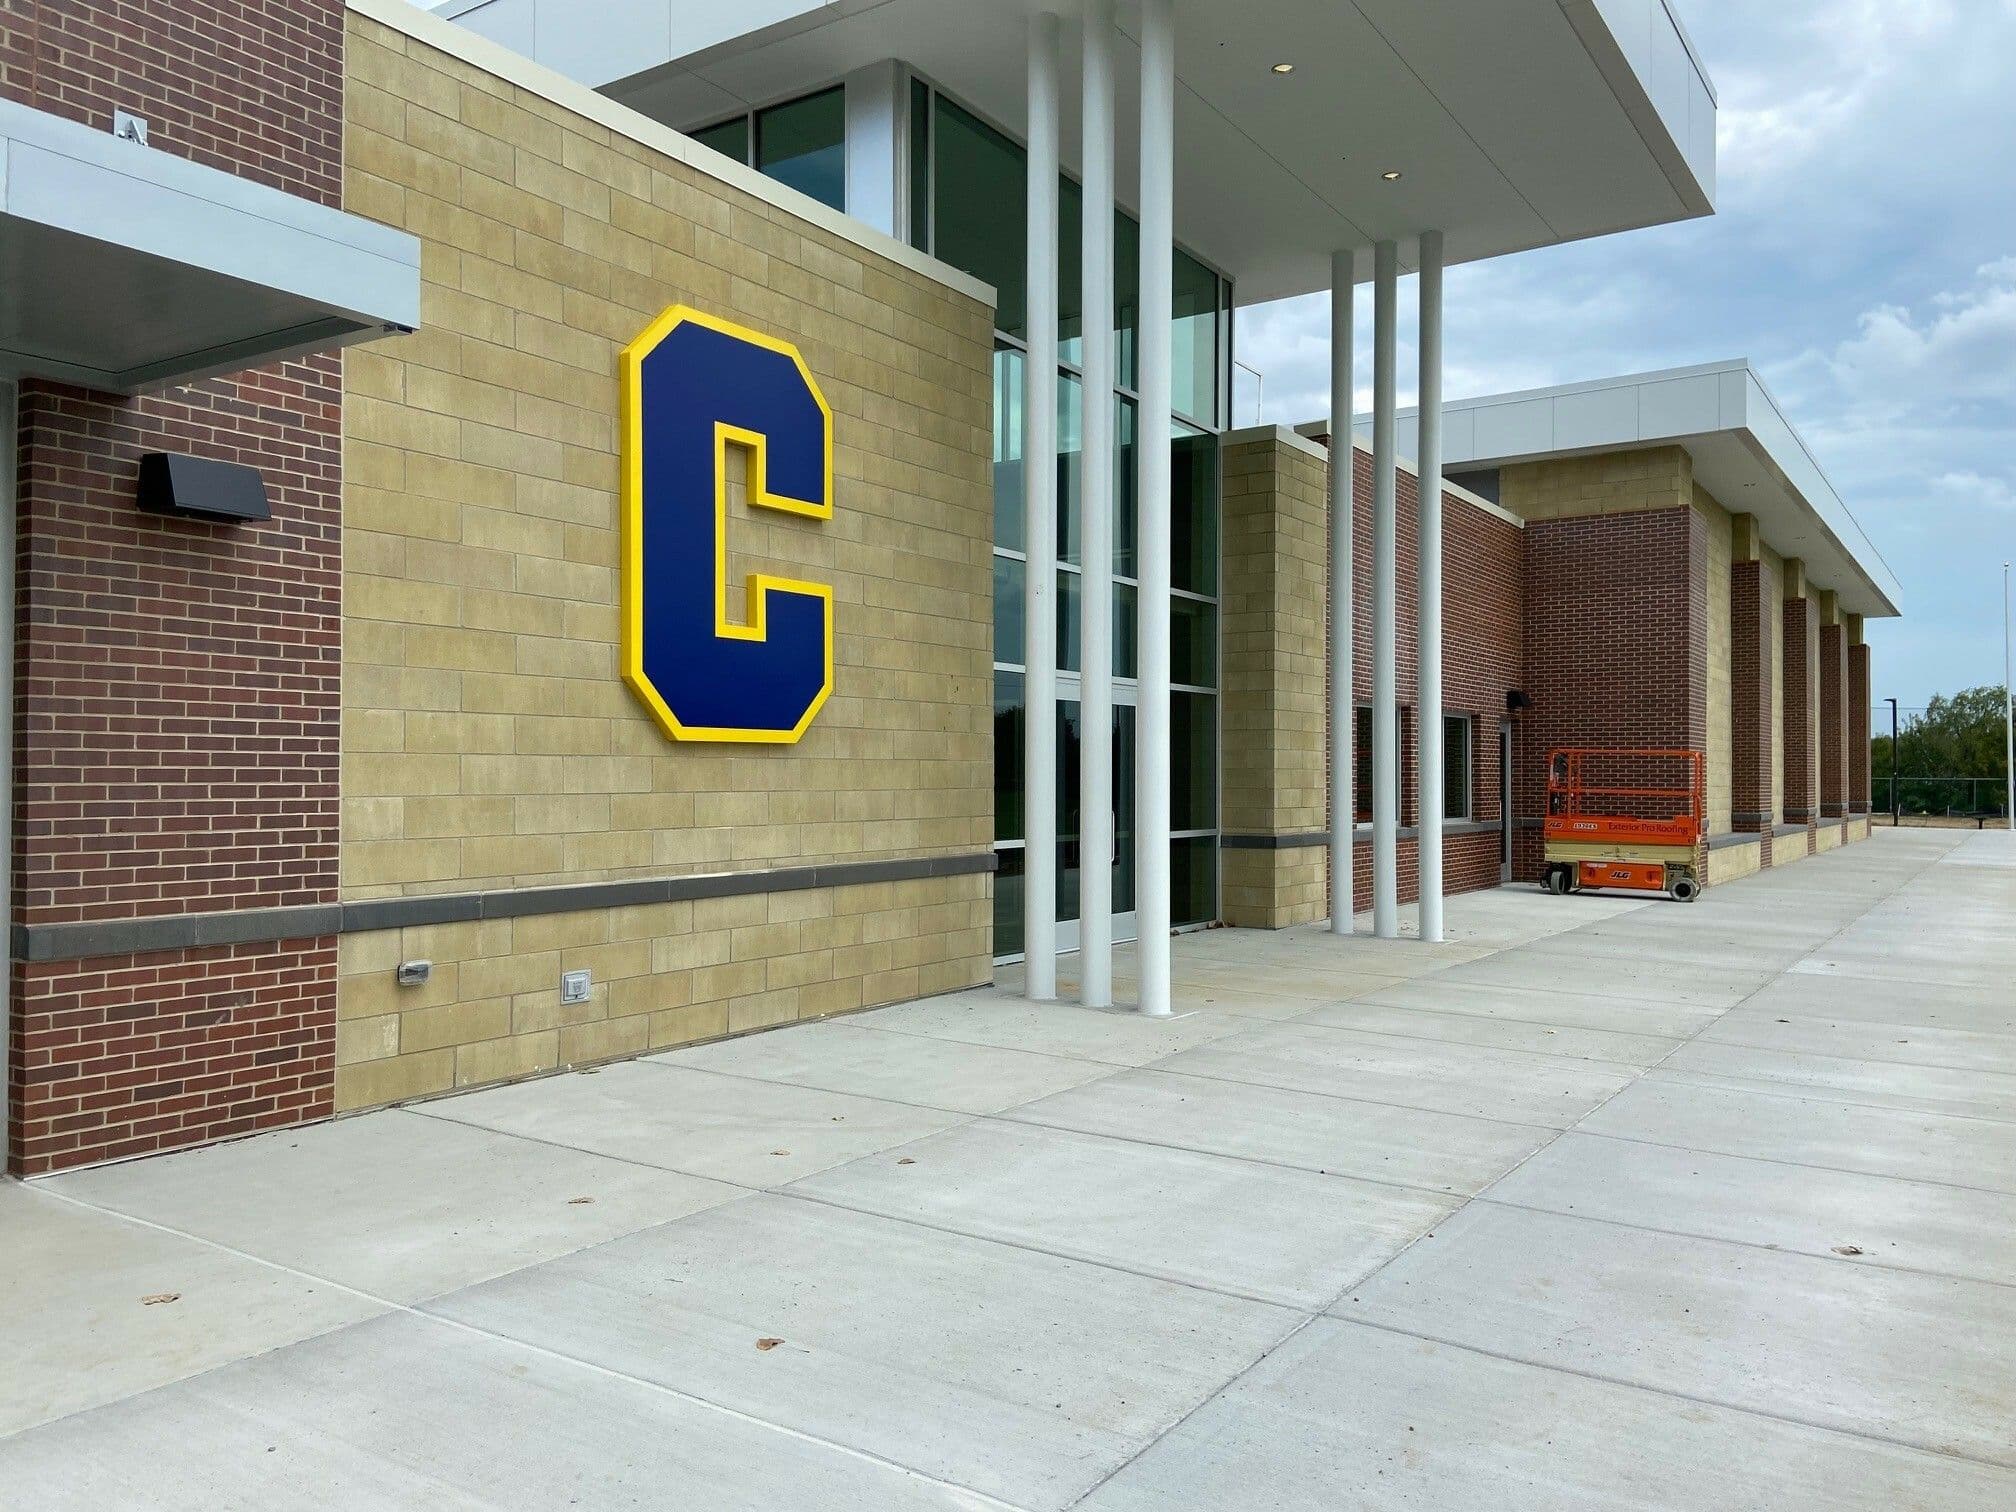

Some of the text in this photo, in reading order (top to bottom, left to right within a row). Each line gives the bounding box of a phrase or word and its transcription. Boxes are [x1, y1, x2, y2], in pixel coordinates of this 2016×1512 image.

[620, 304, 833, 744] C
[1608, 822, 1688, 834] Exterior Pro Roofing
[1610, 871, 1631, 879] JLG
